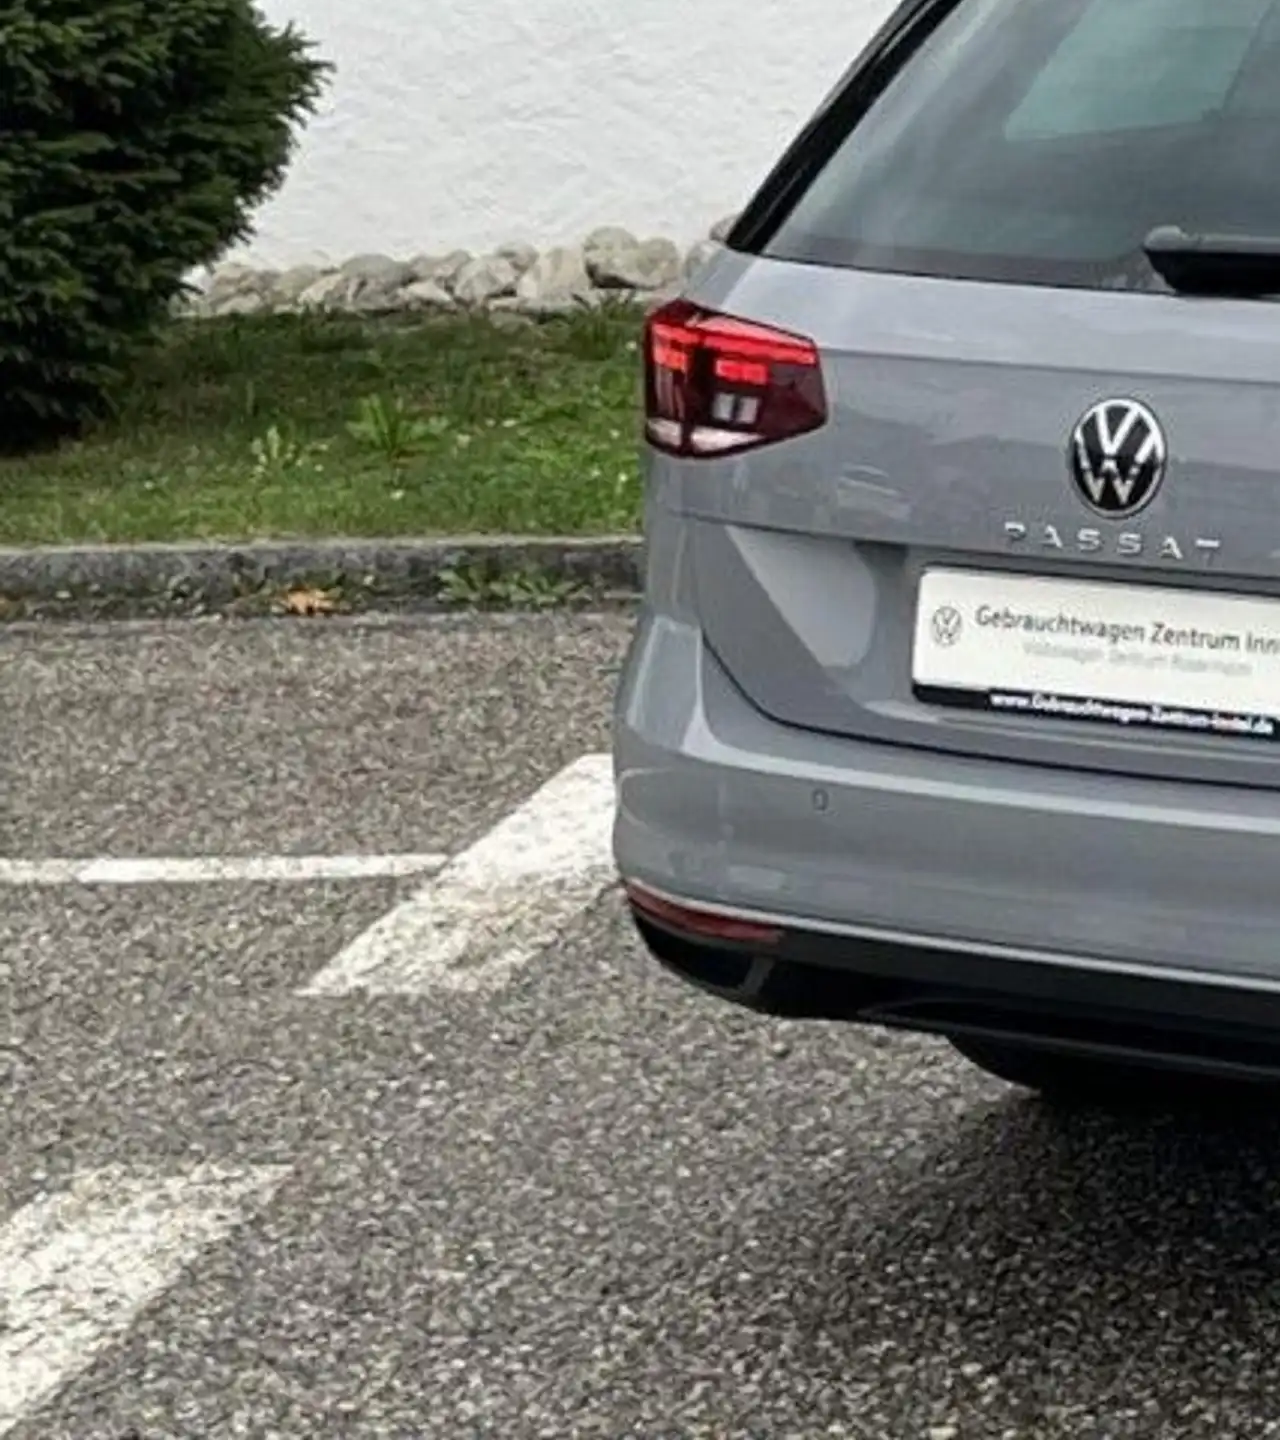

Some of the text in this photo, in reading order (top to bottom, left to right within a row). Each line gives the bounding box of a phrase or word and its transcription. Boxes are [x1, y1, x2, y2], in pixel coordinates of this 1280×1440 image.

[1070, 397, 1167, 519] VW
[1004, 520, 1222, 564] PASSAT
[975, 604, 1146, 644] Gebrauchtwagen
[1149, 621, 1241, 651] Zentrum
